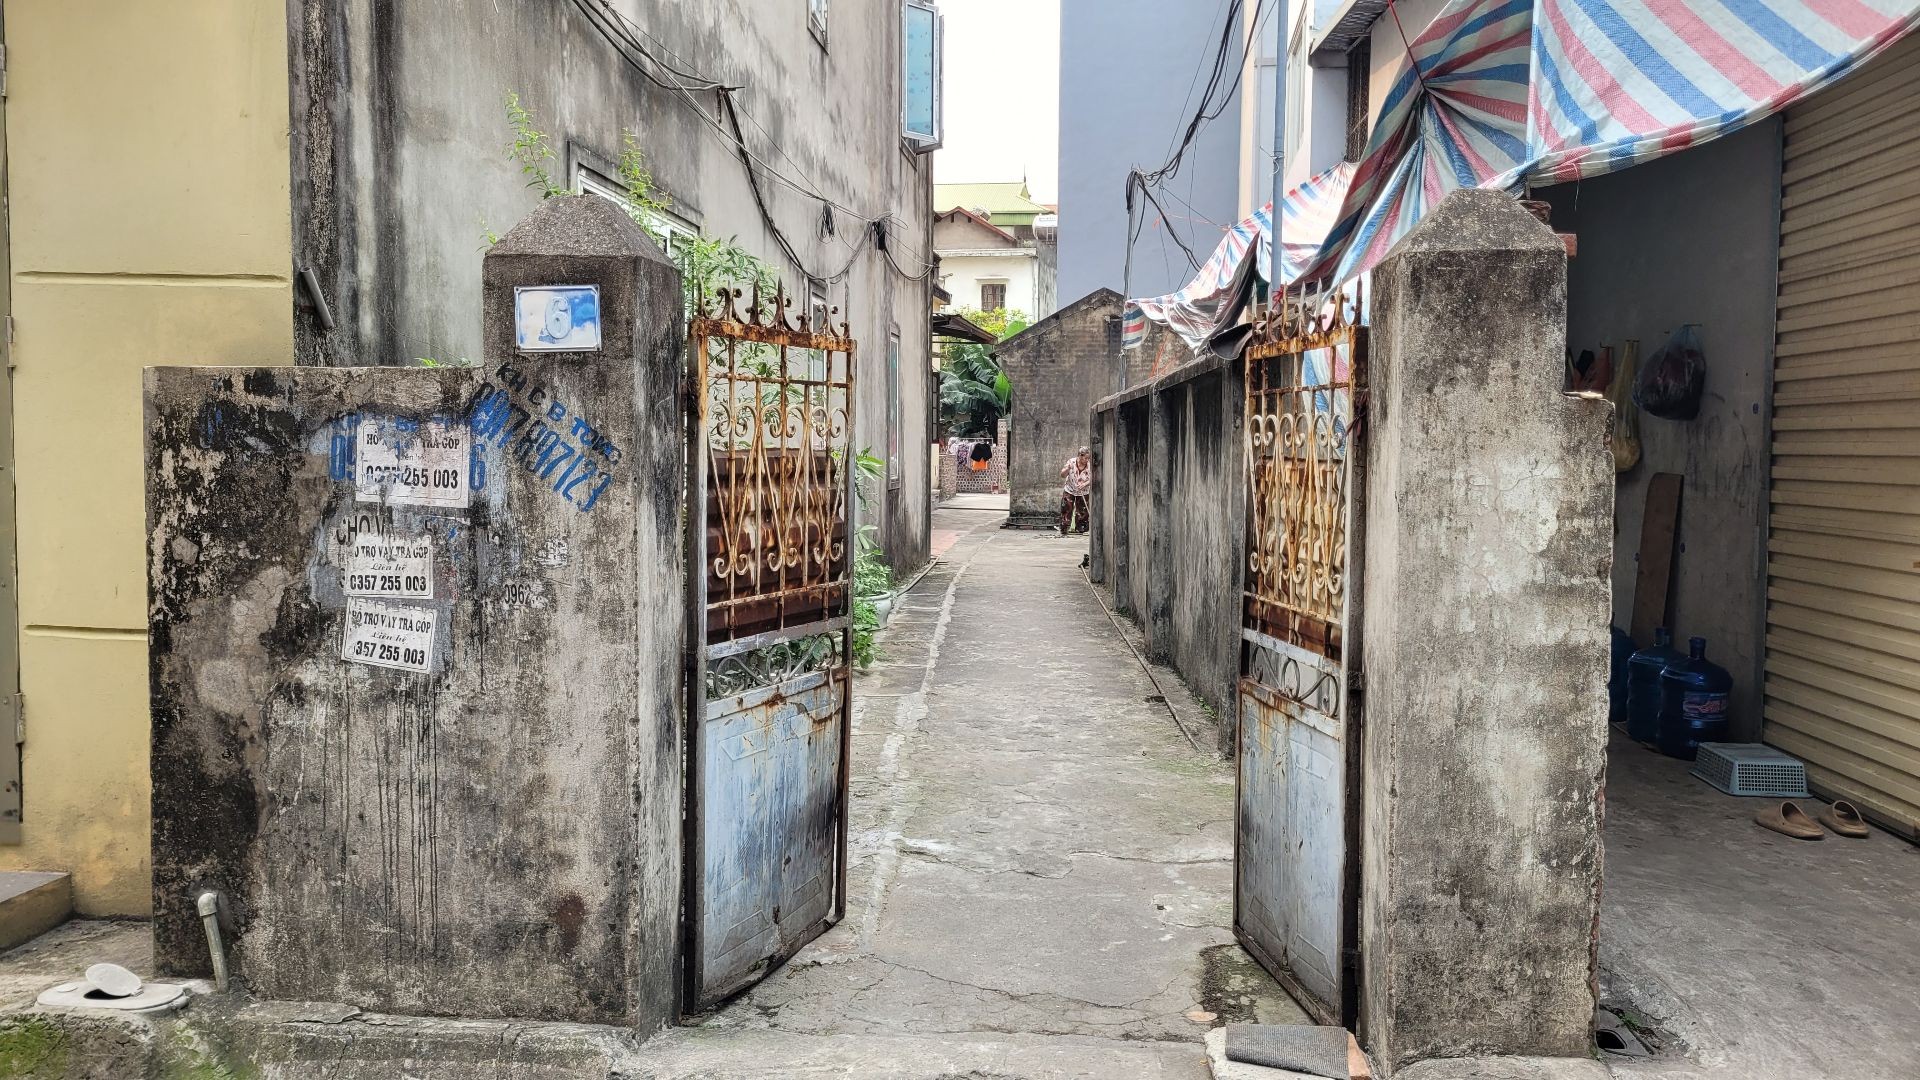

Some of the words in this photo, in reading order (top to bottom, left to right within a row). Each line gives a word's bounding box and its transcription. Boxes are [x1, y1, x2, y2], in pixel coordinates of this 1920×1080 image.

[404, 466, 428, 487] 255
[433, 469, 458, 489] 003
[350, 575, 377, 590] 0357
[381, 575, 401, 590] 255
[406, 576, 427, 591] 003
[353, 641, 377, 657] 357
[379, 644, 400, 661] 255
[404, 648, 425, 665] 003
